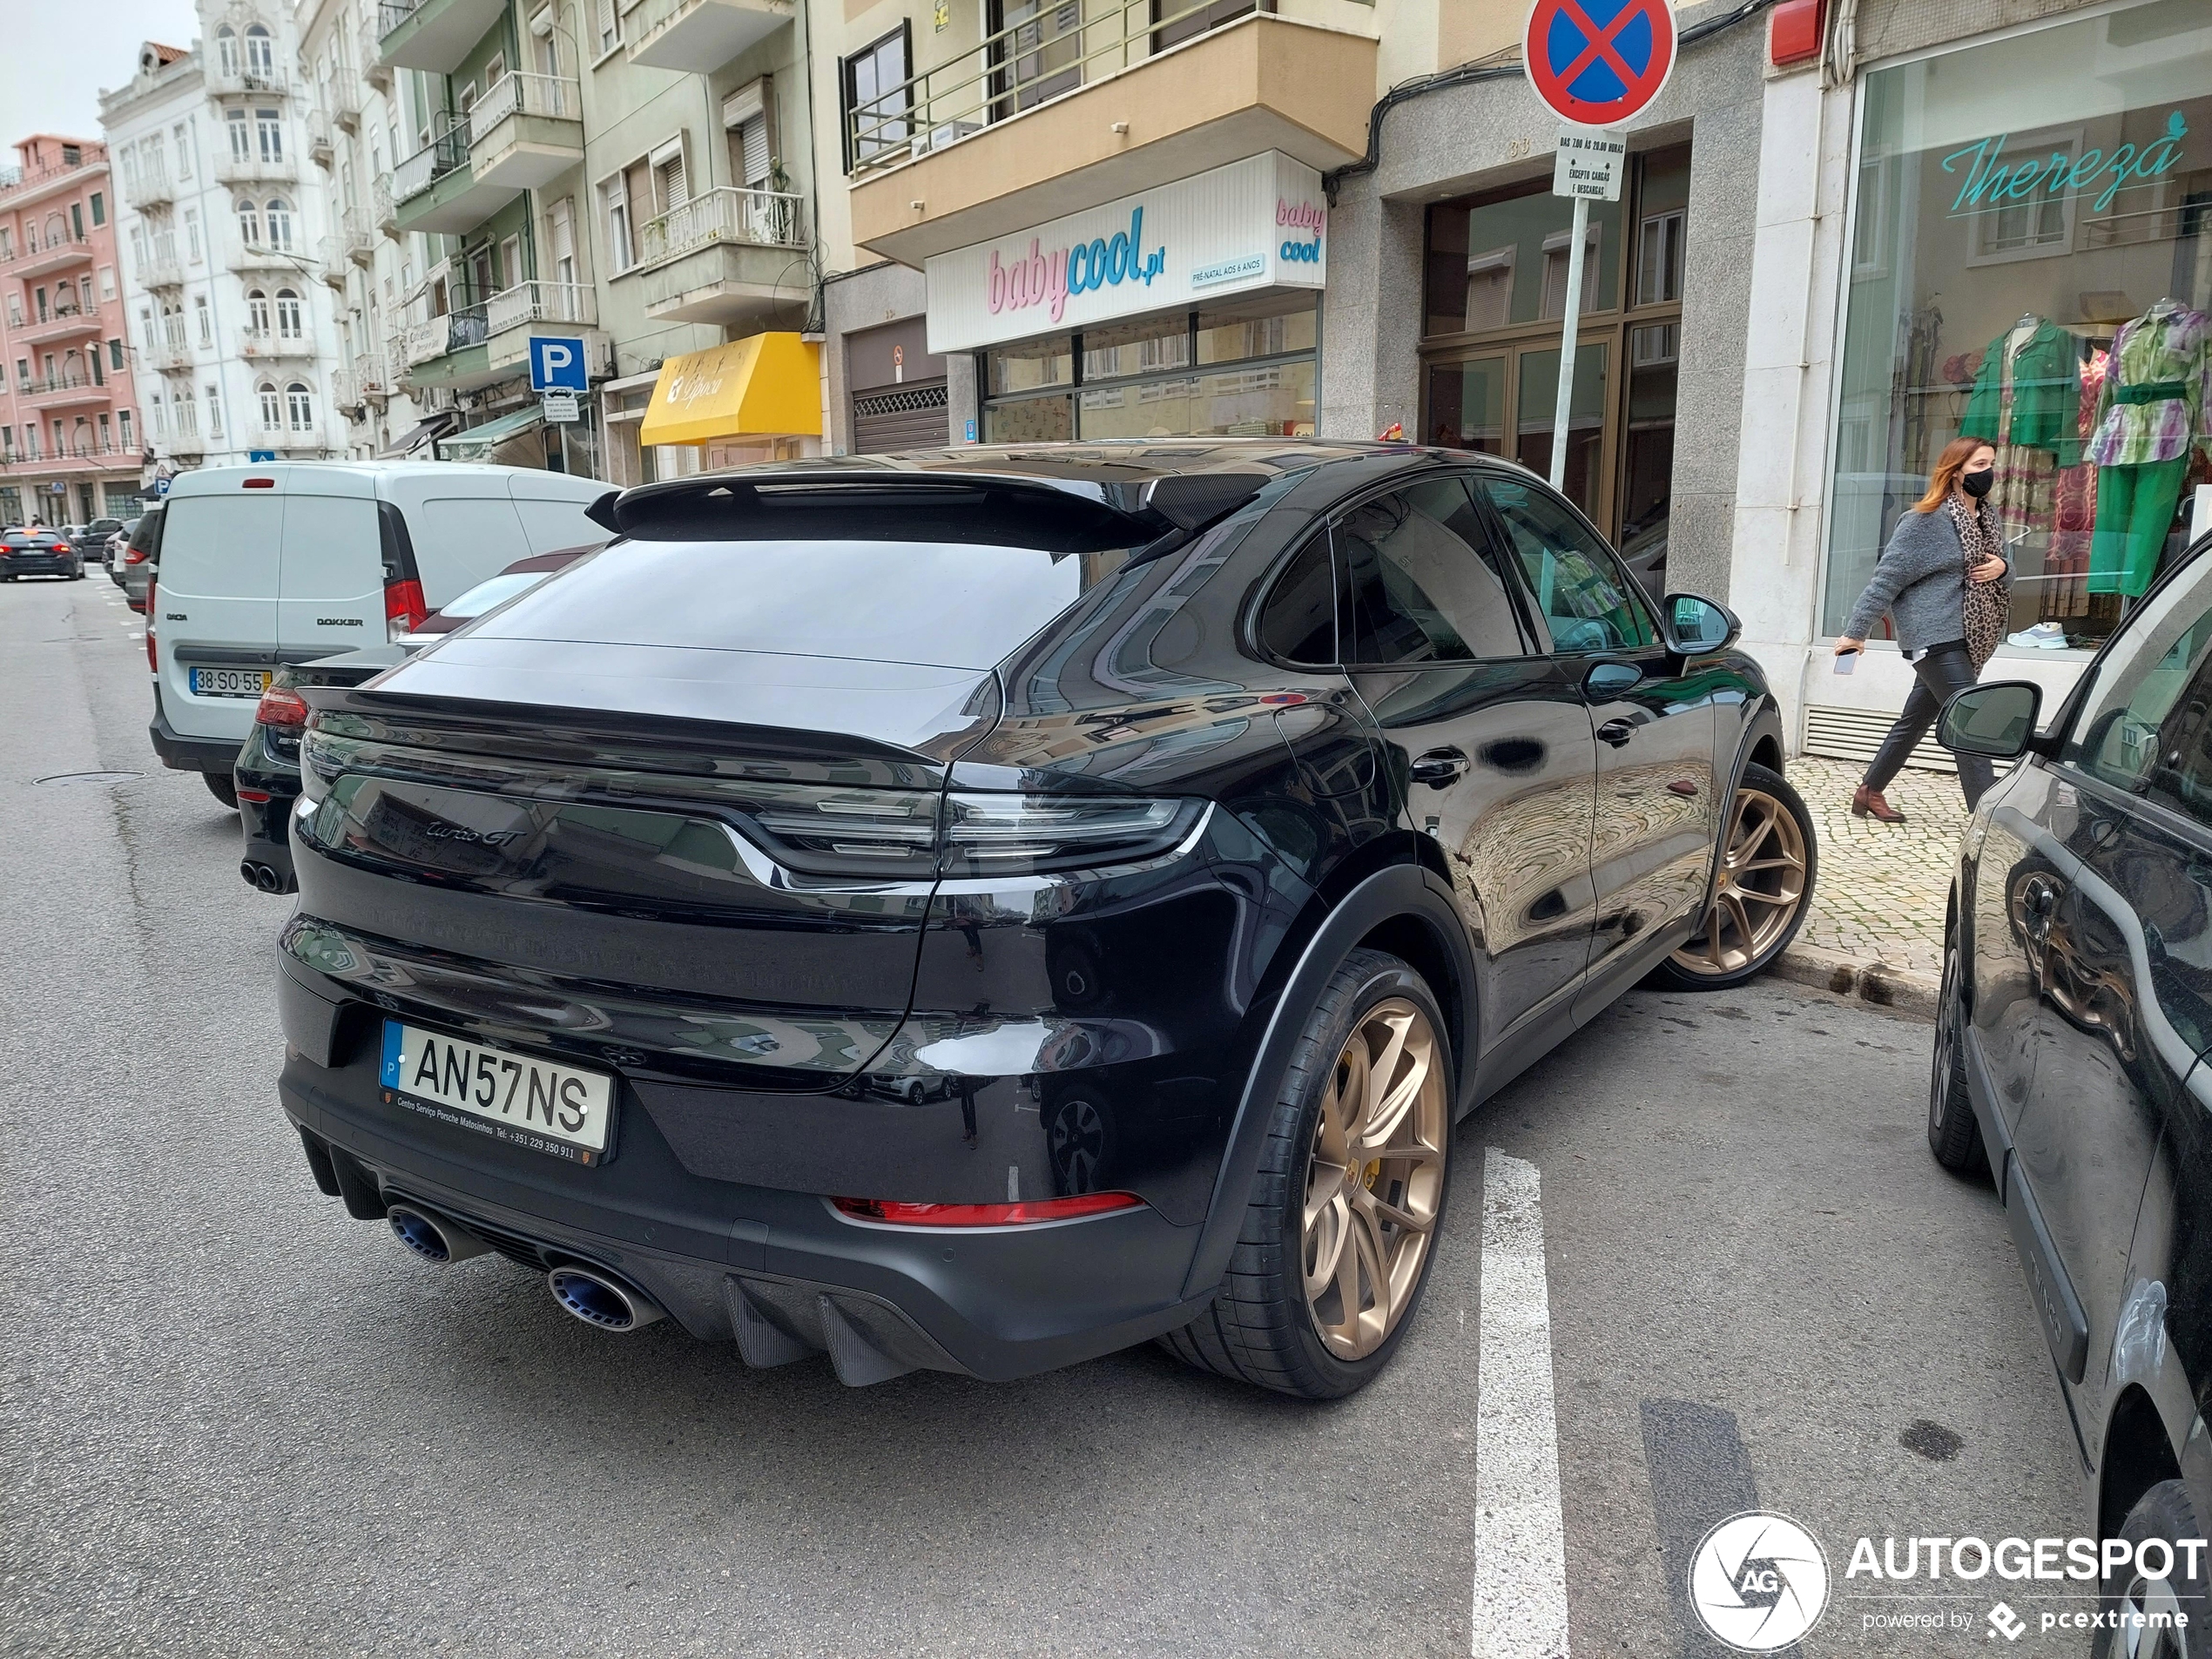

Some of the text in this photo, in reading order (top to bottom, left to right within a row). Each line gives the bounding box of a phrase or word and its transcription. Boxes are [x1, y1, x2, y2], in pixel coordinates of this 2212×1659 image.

[1510, 136, 1529, 157] 33
[1560, 137, 1571, 147] DAS
[1572, 138, 1583, 149] 7.00
[1592, 141, 1608, 152] 20.00
[1608, 142, 1624, 154] HORAS
[1568, 169, 1611, 182] EXCEPTO CARGAS
[1942, 132, 2185, 212] Thereza
[1572, 183, 1605, 196] E DESCARGAS
[1276, 199, 1326, 237] baby
[1280, 238, 1321, 263] cool
[988, 206, 1165, 323] babycool.pt
[1192, 260, 1261, 283] PRÉ-NATAL AOS 6 ANOS
[542, 344, 573, 383] P
[158, 480, 170, 493] P
[482, 829, 529, 847] GT
[387, 1062, 395, 1076] P
[397, 1097, 575, 1159] Centro Serviço Porsche Matosinhos Tel: +351 229 350 911
